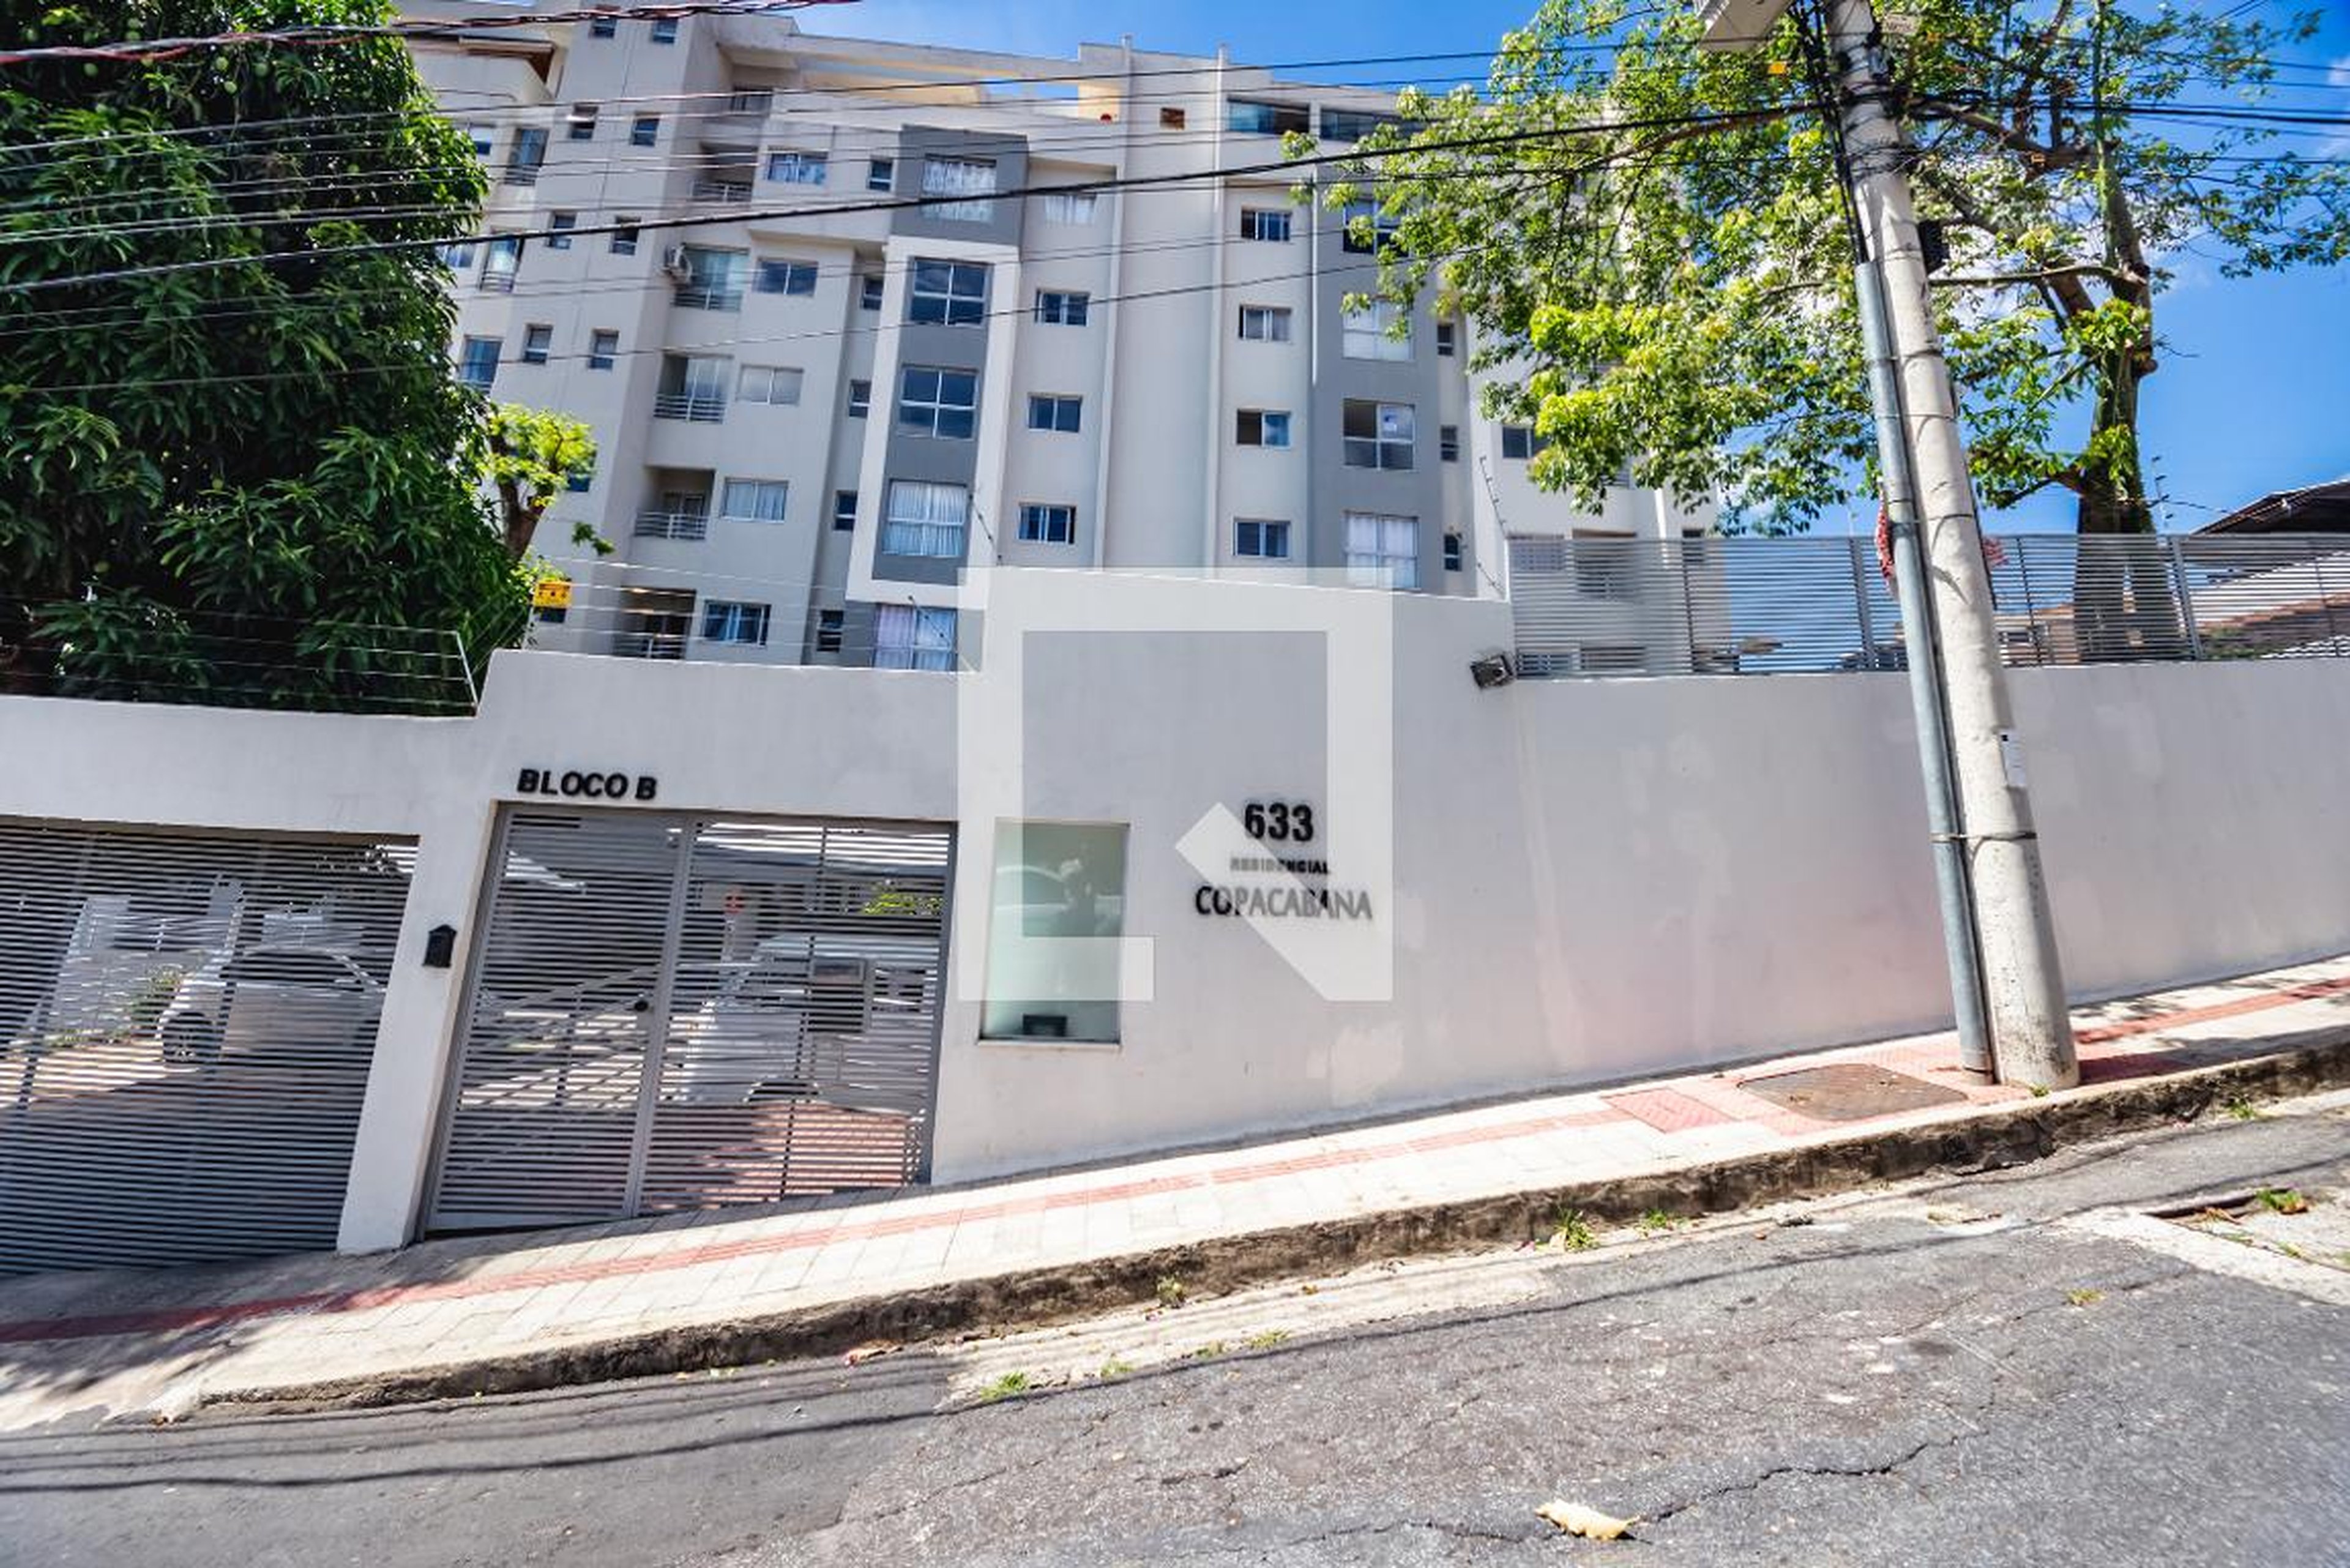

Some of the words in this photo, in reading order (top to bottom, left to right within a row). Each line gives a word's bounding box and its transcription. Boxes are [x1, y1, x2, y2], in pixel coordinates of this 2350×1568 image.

[517, 769, 628, 797] BLOCO
[635, 776, 657, 799] B
[1245, 802, 1313, 842] 633
[1195, 886, 1372, 918] COPACABANA
